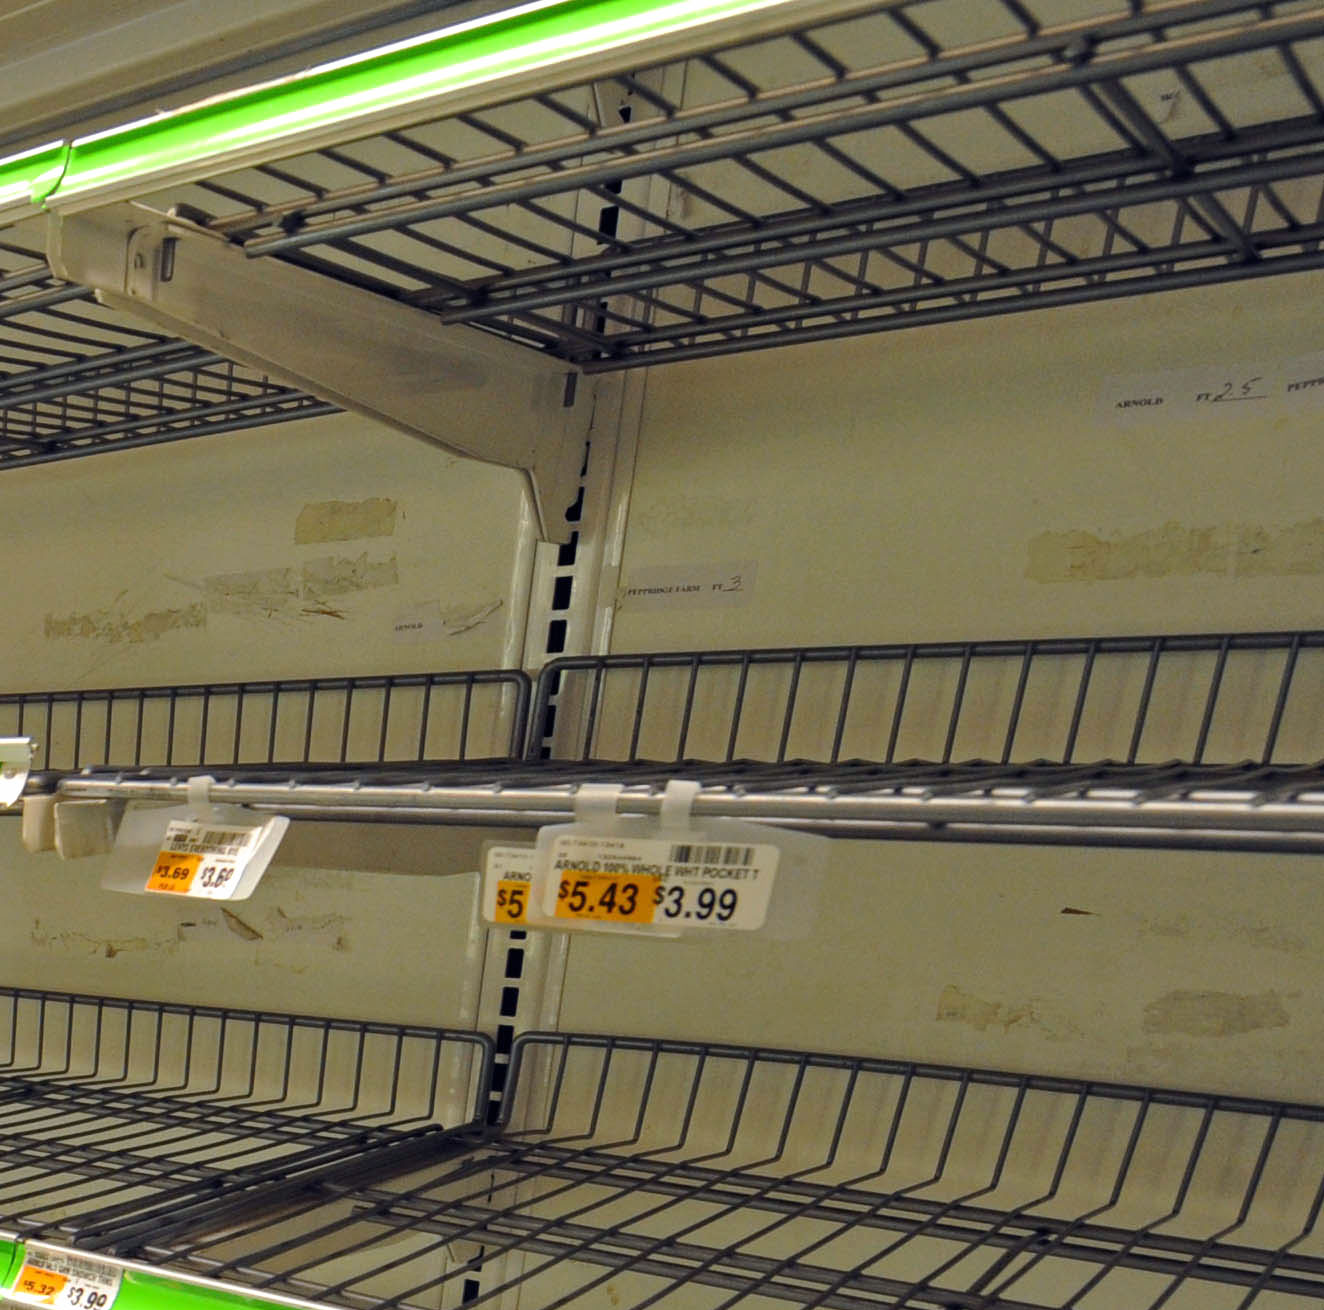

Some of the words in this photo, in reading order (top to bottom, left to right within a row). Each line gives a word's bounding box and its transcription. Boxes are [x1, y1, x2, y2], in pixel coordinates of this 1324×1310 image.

[155, 864, 190, 881] $3.69
[554, 859, 601, 873] ARNOLD
[702, 866, 749, 880] POCKET
[558, 879, 639, 916] $5.43
[653, 885, 738, 922] $3.99
